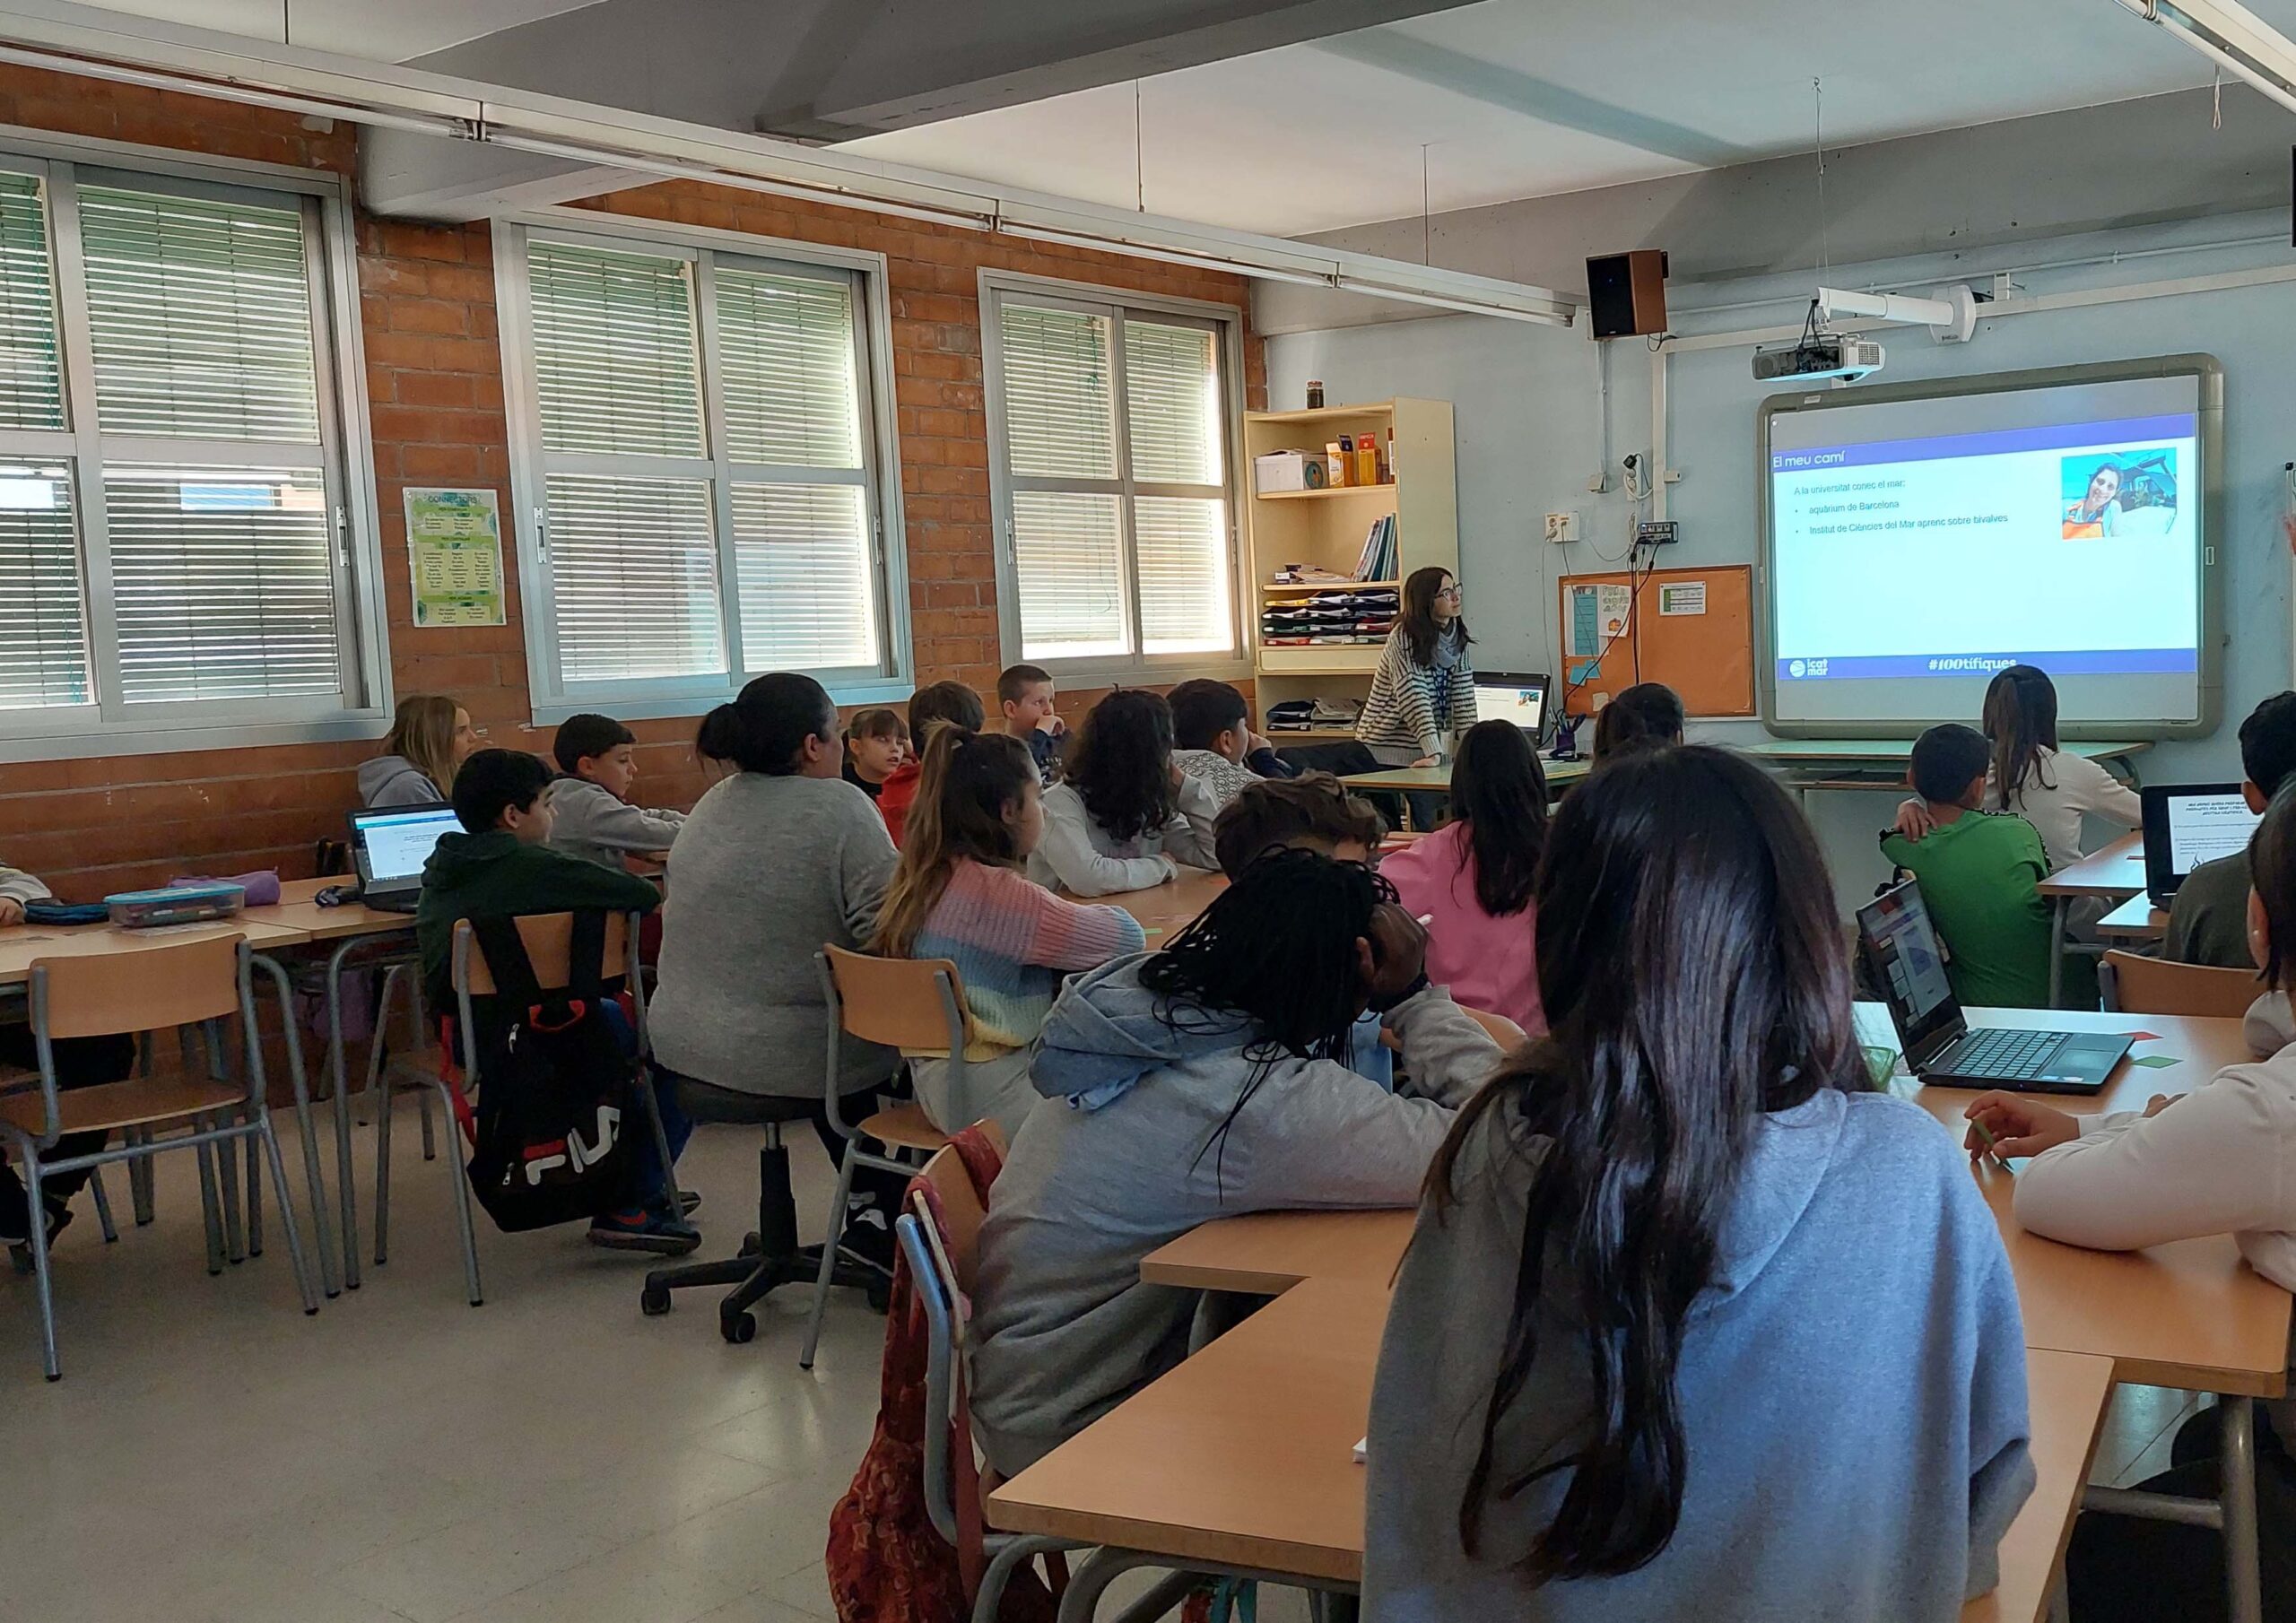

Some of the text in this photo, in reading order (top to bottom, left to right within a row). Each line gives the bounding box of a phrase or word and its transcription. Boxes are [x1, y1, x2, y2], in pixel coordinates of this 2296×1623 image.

[1772, 450, 1846, 468] El meu camí
[1794, 487, 1801, 495] A
[1802, 486, 1809, 494] la
[1811, 482, 1850, 493] universitat
[1852, 482, 1876, 490] conec
[1877, 480, 1885, 489] el
[1847, 503, 1857, 512] de
[1859, 500, 1900, 510] Barcelona
[1809, 525, 1835, 534] Institut
[1837, 524, 1847, 533] de
[1884, 520, 1898, 530] del
[1899, 519, 1915, 529] Mar
[1917, 518, 1946, 529] aprenc
[1947, 516, 1971, 526] sobre
[1973, 514, 2008, 524] bivalves
[1806, 658, 1828, 668] icat
[1807, 668, 1829, 676] mar
